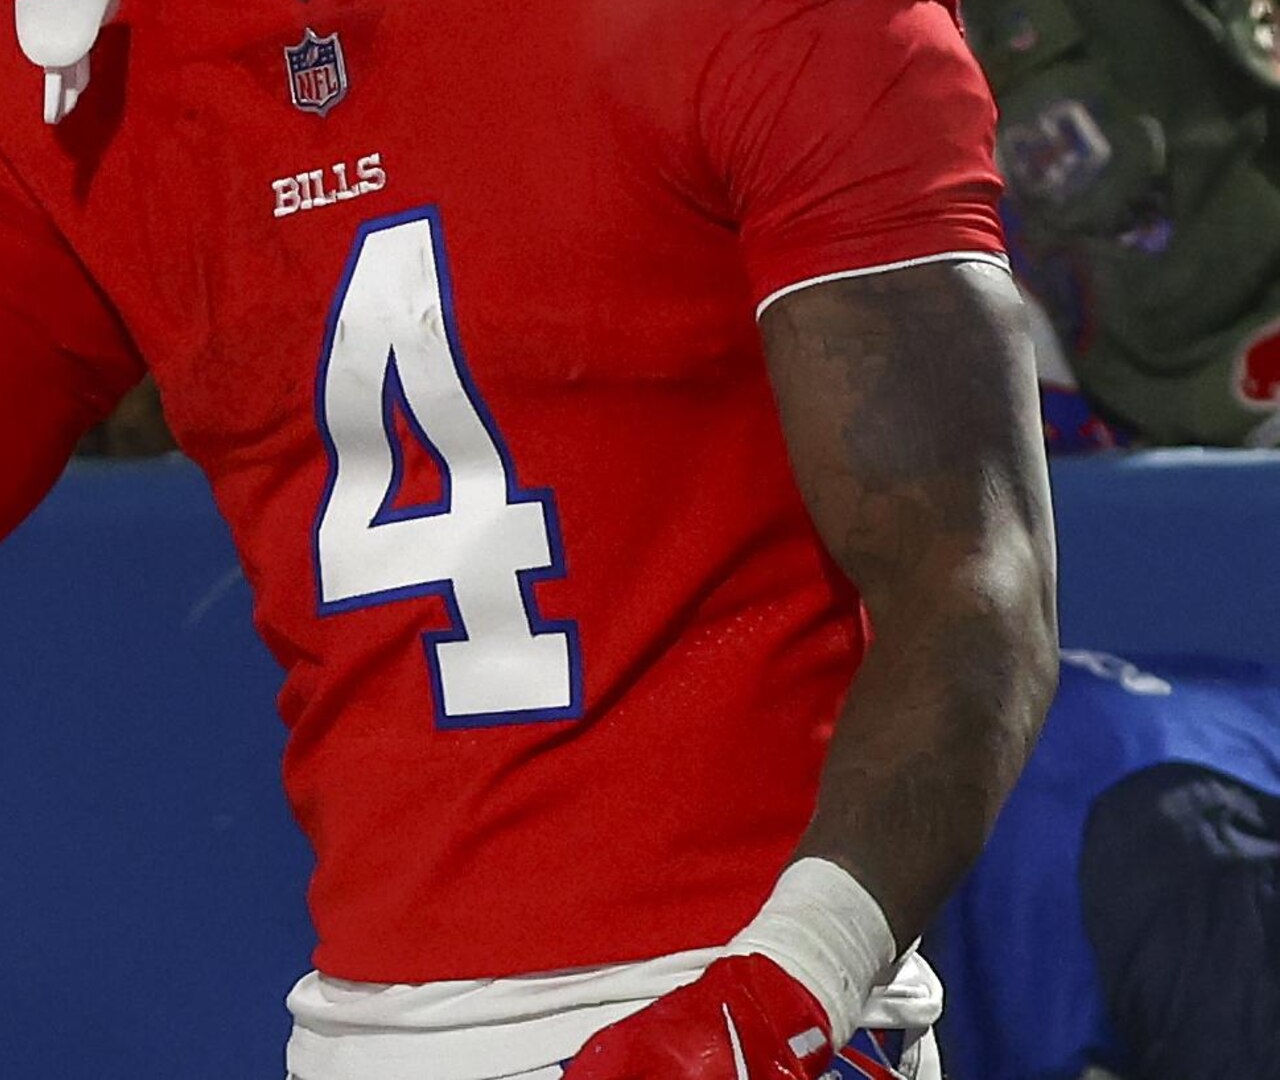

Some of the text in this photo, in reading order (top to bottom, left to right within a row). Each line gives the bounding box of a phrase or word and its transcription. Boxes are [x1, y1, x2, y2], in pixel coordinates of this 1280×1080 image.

[297, 67, 337, 101] NFL
[271, 152, 386, 218] BILLS
[316, 205, 583, 730] 4
